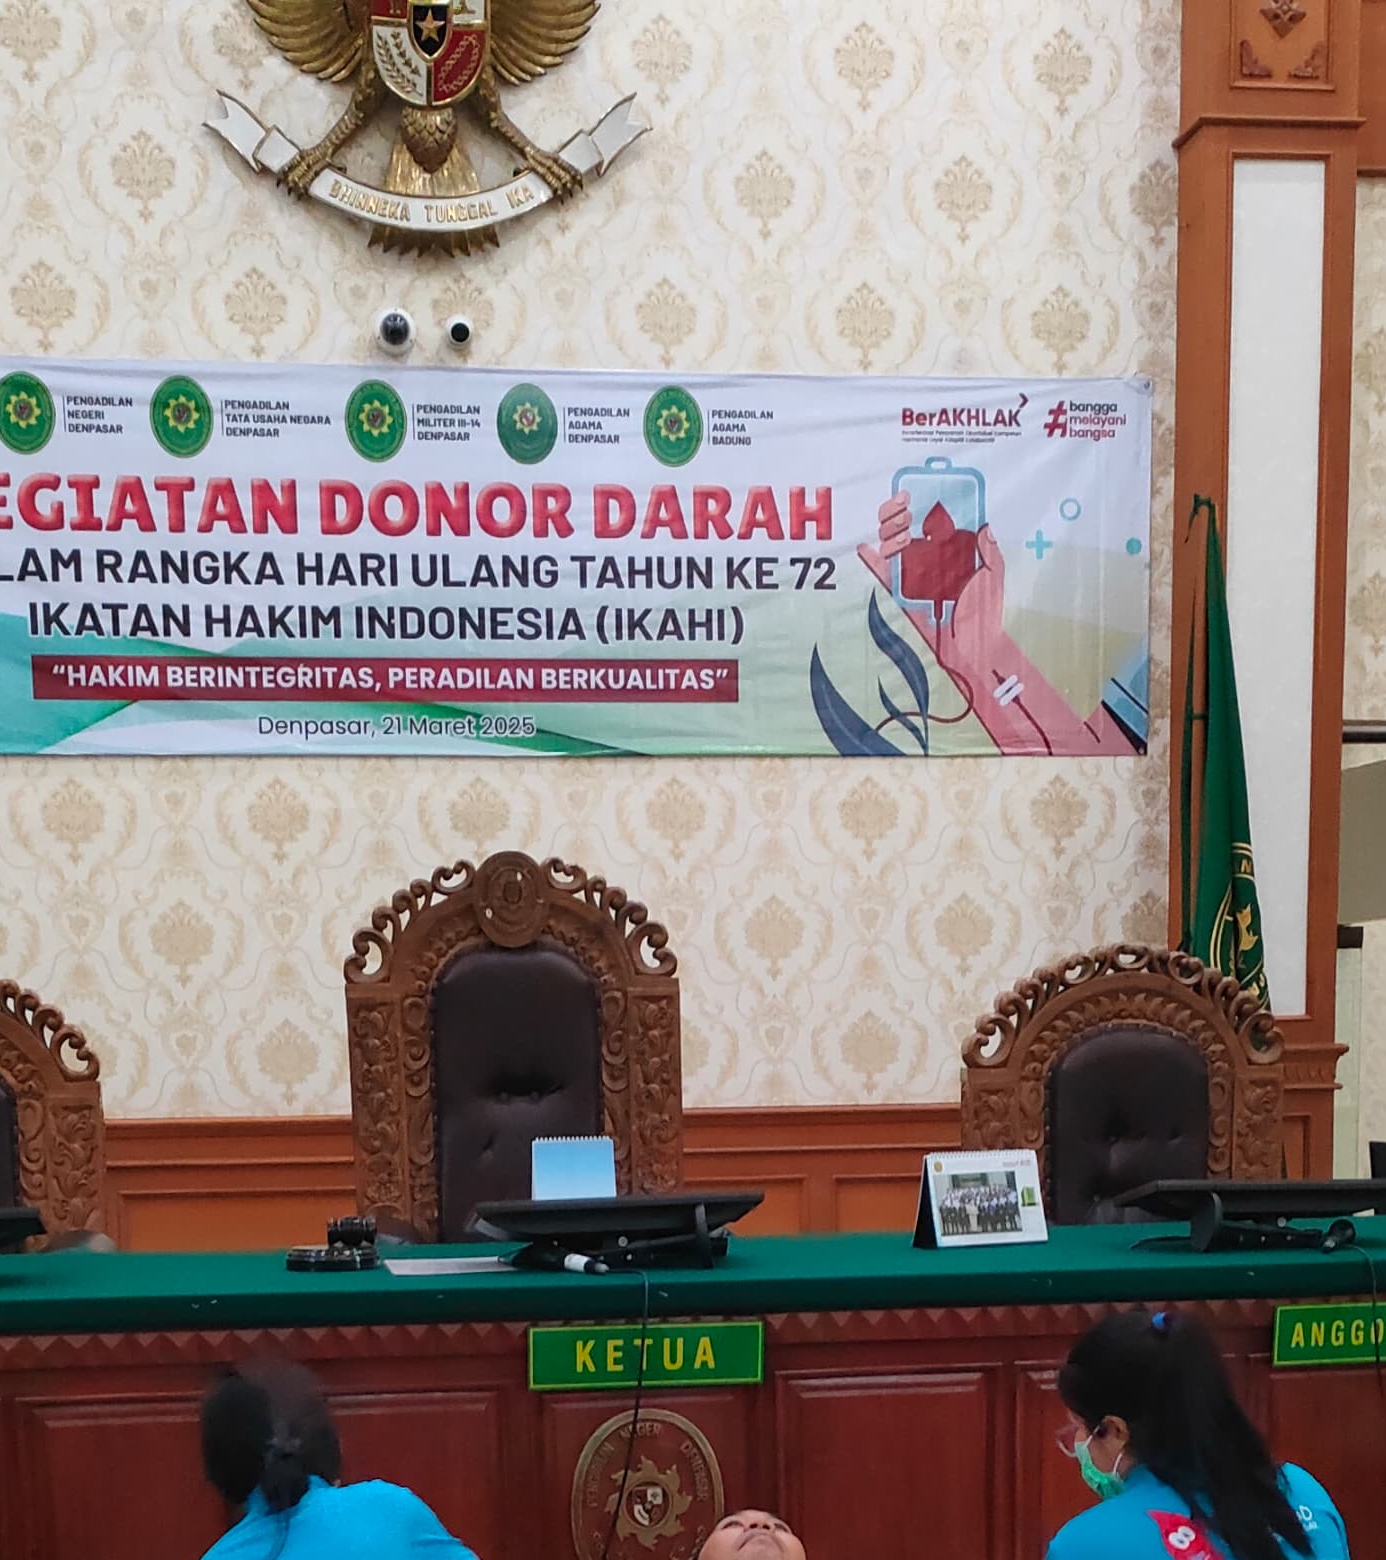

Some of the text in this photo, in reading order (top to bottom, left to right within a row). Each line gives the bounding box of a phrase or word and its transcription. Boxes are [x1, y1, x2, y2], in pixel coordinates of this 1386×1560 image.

[66, 395, 133, 407] PENGADILAN
[224, 400, 290, 411] PENGADILAN
[416, 404, 480, 415] PENGADILAN
[567, 407, 630, 418] PENGADILAN
[1069, 401, 1117, 415] bangga
[67, 409, 105, 420] NEGERI
[225, 413, 331, 426] TATA USAHA NEGARA
[711, 409, 774, 420] PENGADILAN
[901, 407, 1023, 428] BerAKHLAK
[417, 418, 456, 428] MILITER
[568, 421, 603, 431] AGAMA
[712, 423, 747, 433] AGAMA
[68, 424, 123, 434] DENPASAR
[226, 427, 280, 438] DENPASAR
[1069, 428, 1116, 441] bangsa
[417, 431, 470, 442] DENPASAR
[568, 434, 620, 445] DENPASAR
[712, 436, 752, 446] BADUNG
[319, 478, 574, 539] DONOR
[593, 484, 834, 541] DARAH
[96, 549, 285, 586] RANGKA
[297, 552, 398, 587] HARI
[413, 555, 561, 589] ULANG
[570, 555, 713, 590] TAHUN
[726, 557, 780, 590] KE
[790, 557, 837, 590] 72
[29, 603, 746, 646] IKATAN HAKIM INDONESIA (IKAHI)
[53, 664, 729, 692] “HAKIM BERINTEGRITAS, PERADILAN BERKUALITAS”
[259, 716, 535, 739] Denpasar, 21 Maret 2025
[575, 1336, 716, 1372] KETUA
